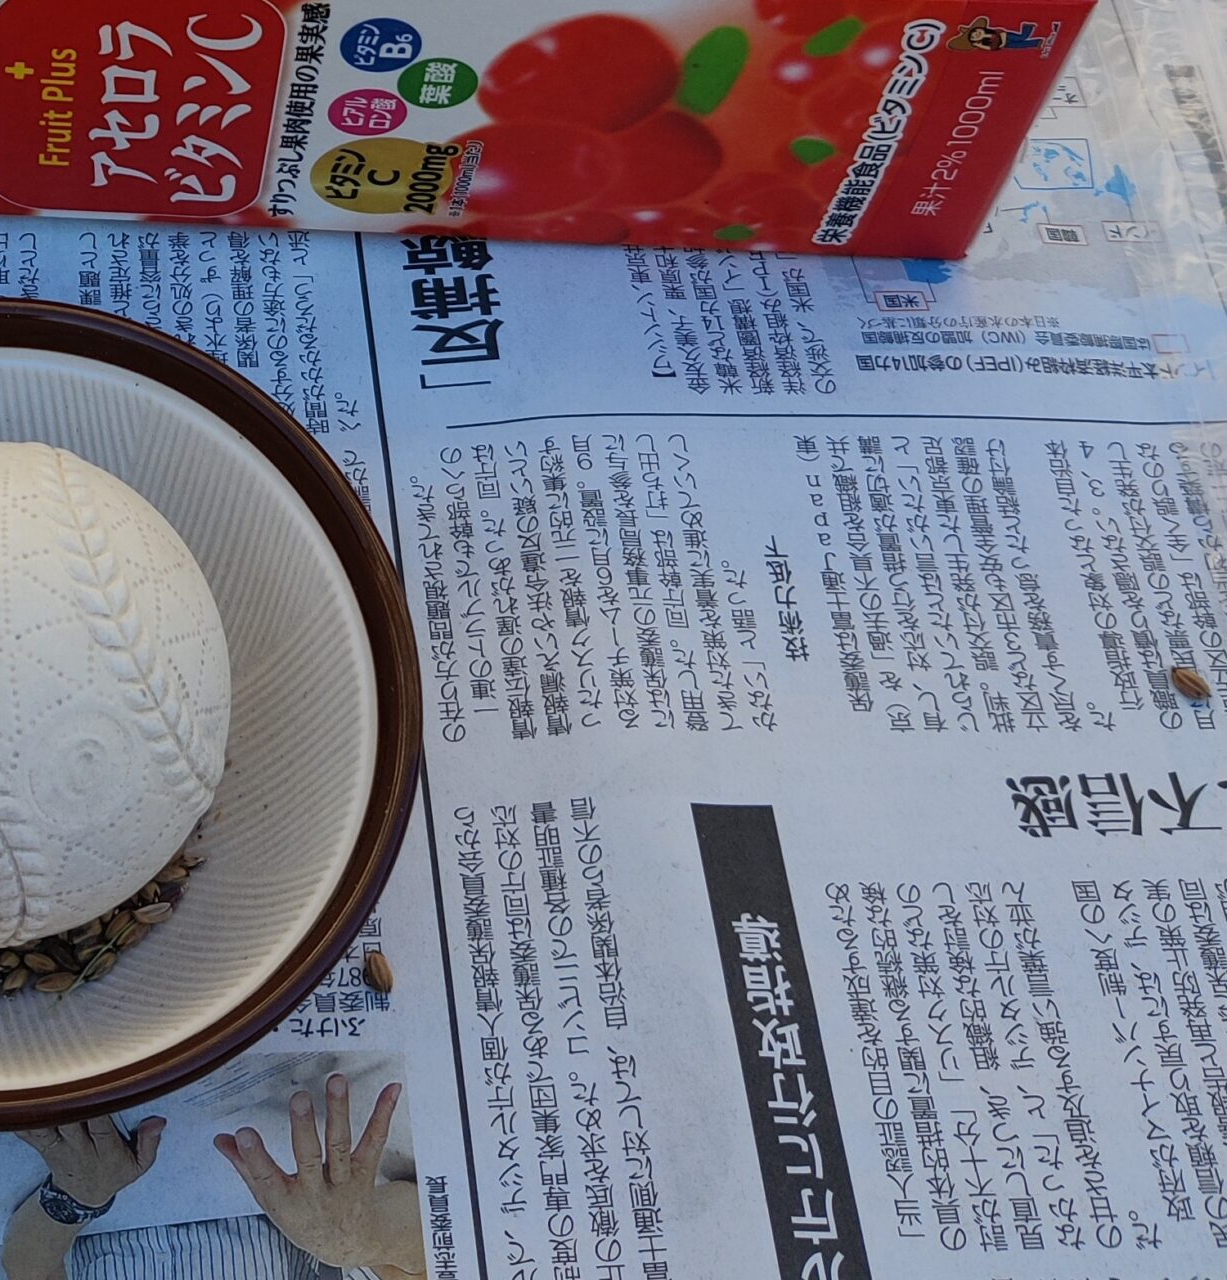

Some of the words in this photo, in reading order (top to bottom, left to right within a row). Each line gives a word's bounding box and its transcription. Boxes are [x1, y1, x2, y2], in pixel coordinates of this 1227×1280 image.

[353, 24, 380, 66] ビタミン
[380, 34, 413, 59] B6
[41, 49, 77, 102] Plus
[418, 63, 458, 104] 葉酸
[88, 20, 173, 187] アセロラ
[164, 13, 263, 203] ビタミンC
[268, 2, 331, 216] すりつぶし果肉使用の果実感
[341, 97, 366, 127] ヒアル
[369, 98, 397, 129] ロン酸
[38, 110, 73, 166] Fruit
[325, 149, 366, 200] ビタミン
[367, 169, 400, 186] C
[404, 144, 459, 213] 2000mg
[882, 294, 917, 308] 米国
[764, 535, 808, 662] 技術力低下
[1087, 701, 1116, 731] た。
[1128, 1210, 1162, 1247] だ。
